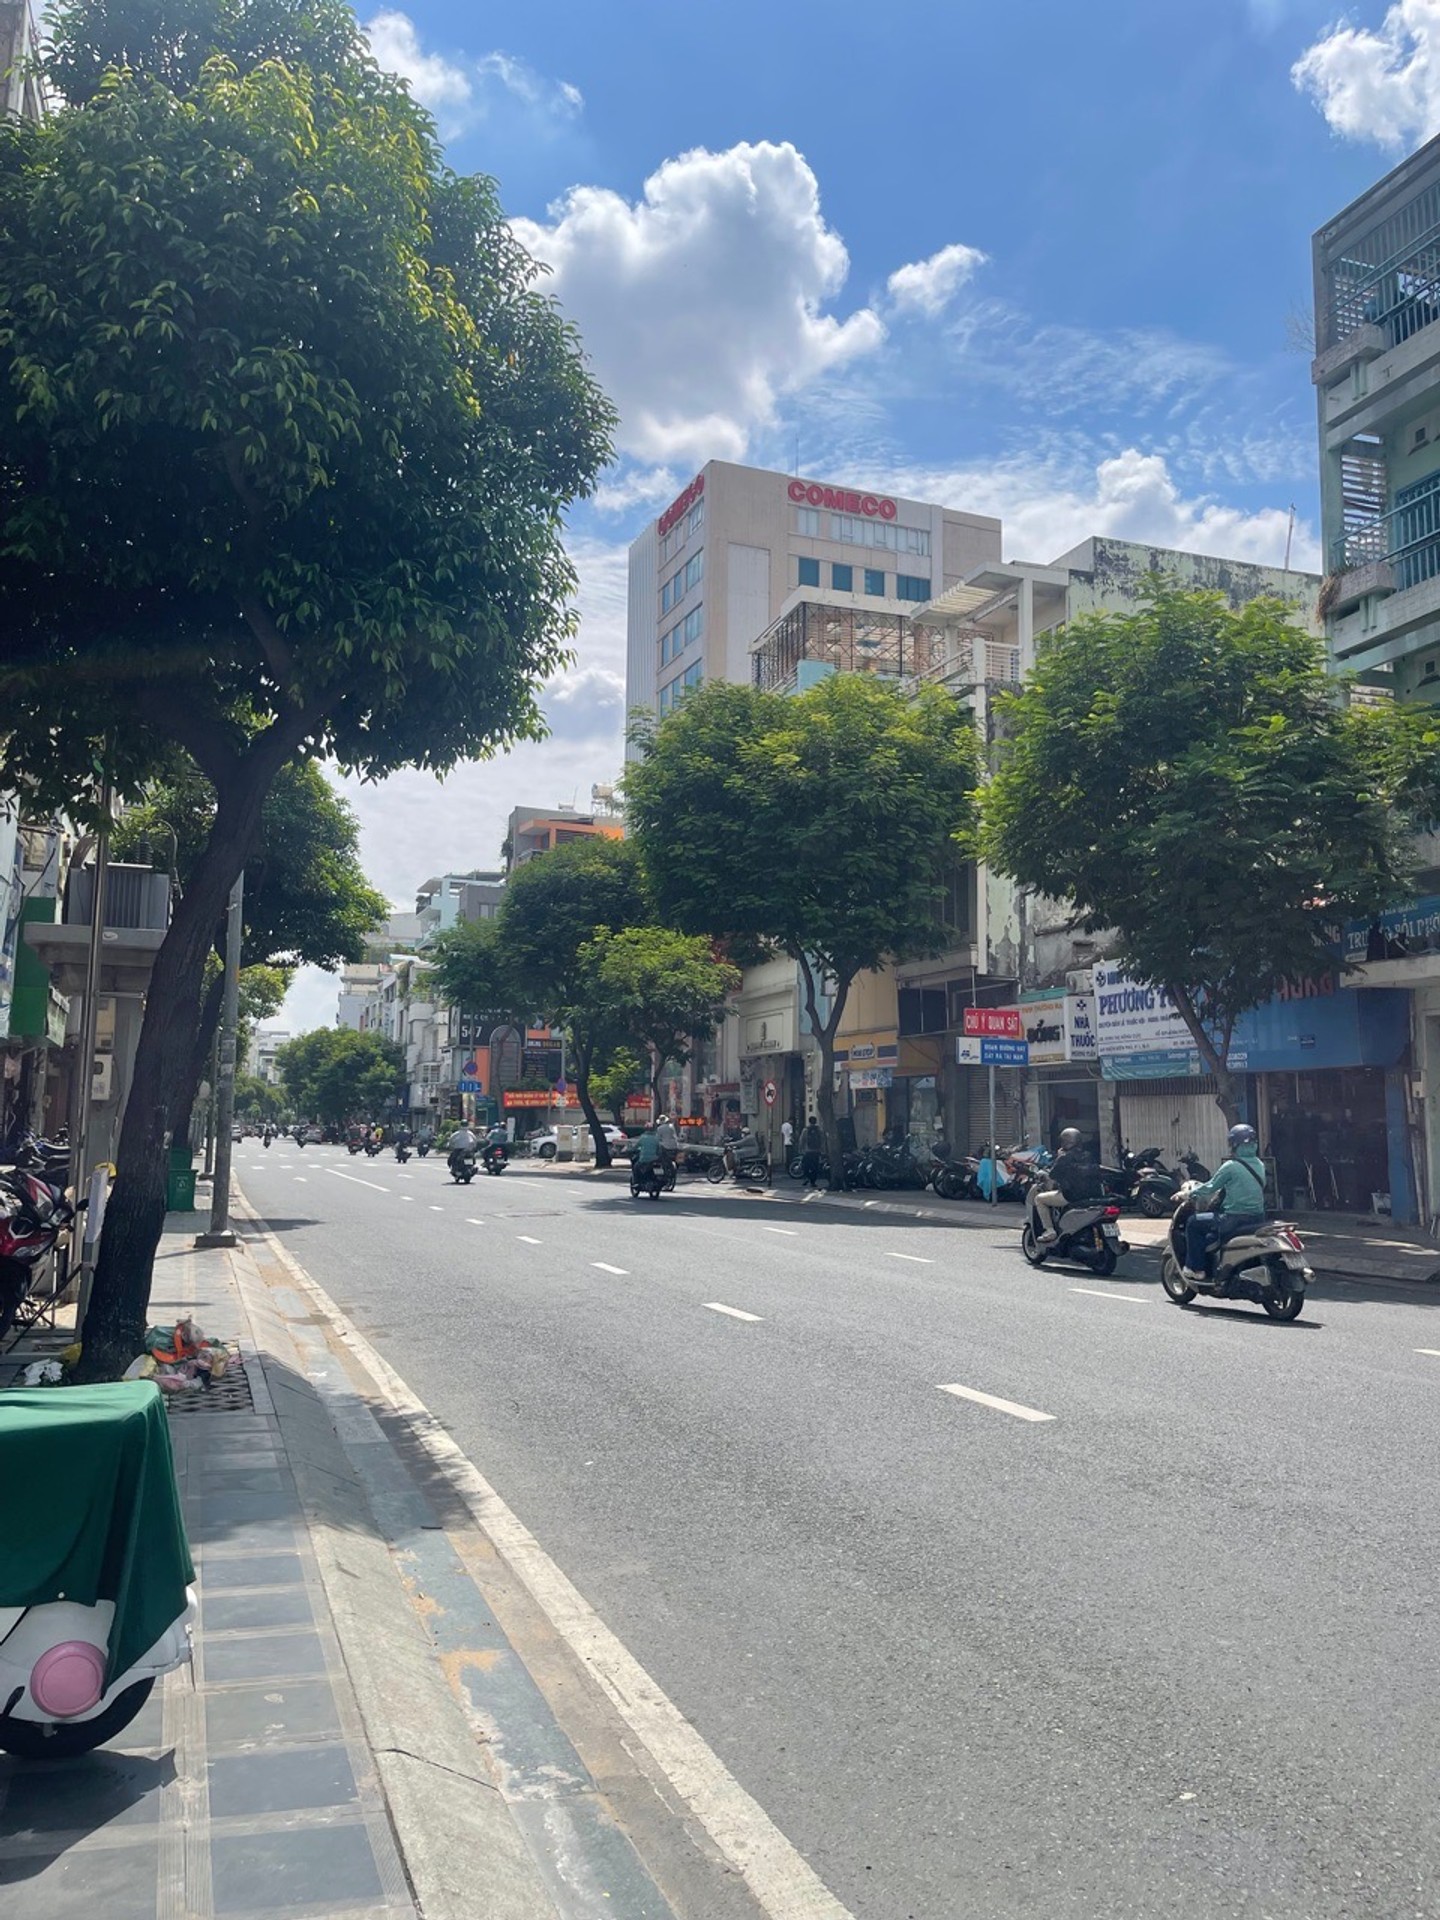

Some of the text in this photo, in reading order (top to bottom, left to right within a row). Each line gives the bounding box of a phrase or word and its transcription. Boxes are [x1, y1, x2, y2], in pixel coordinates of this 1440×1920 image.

[787, 480, 897, 520] COMECO
[1098, 986, 1156, 1016] PHƯƠNG
[966, 1012, 1019, 1031] CHÚ Ý QUAN SÁT
[1074, 1013, 1090, 1029] NHÀ
[1070, 1030, 1096, 1047] THUỐC
